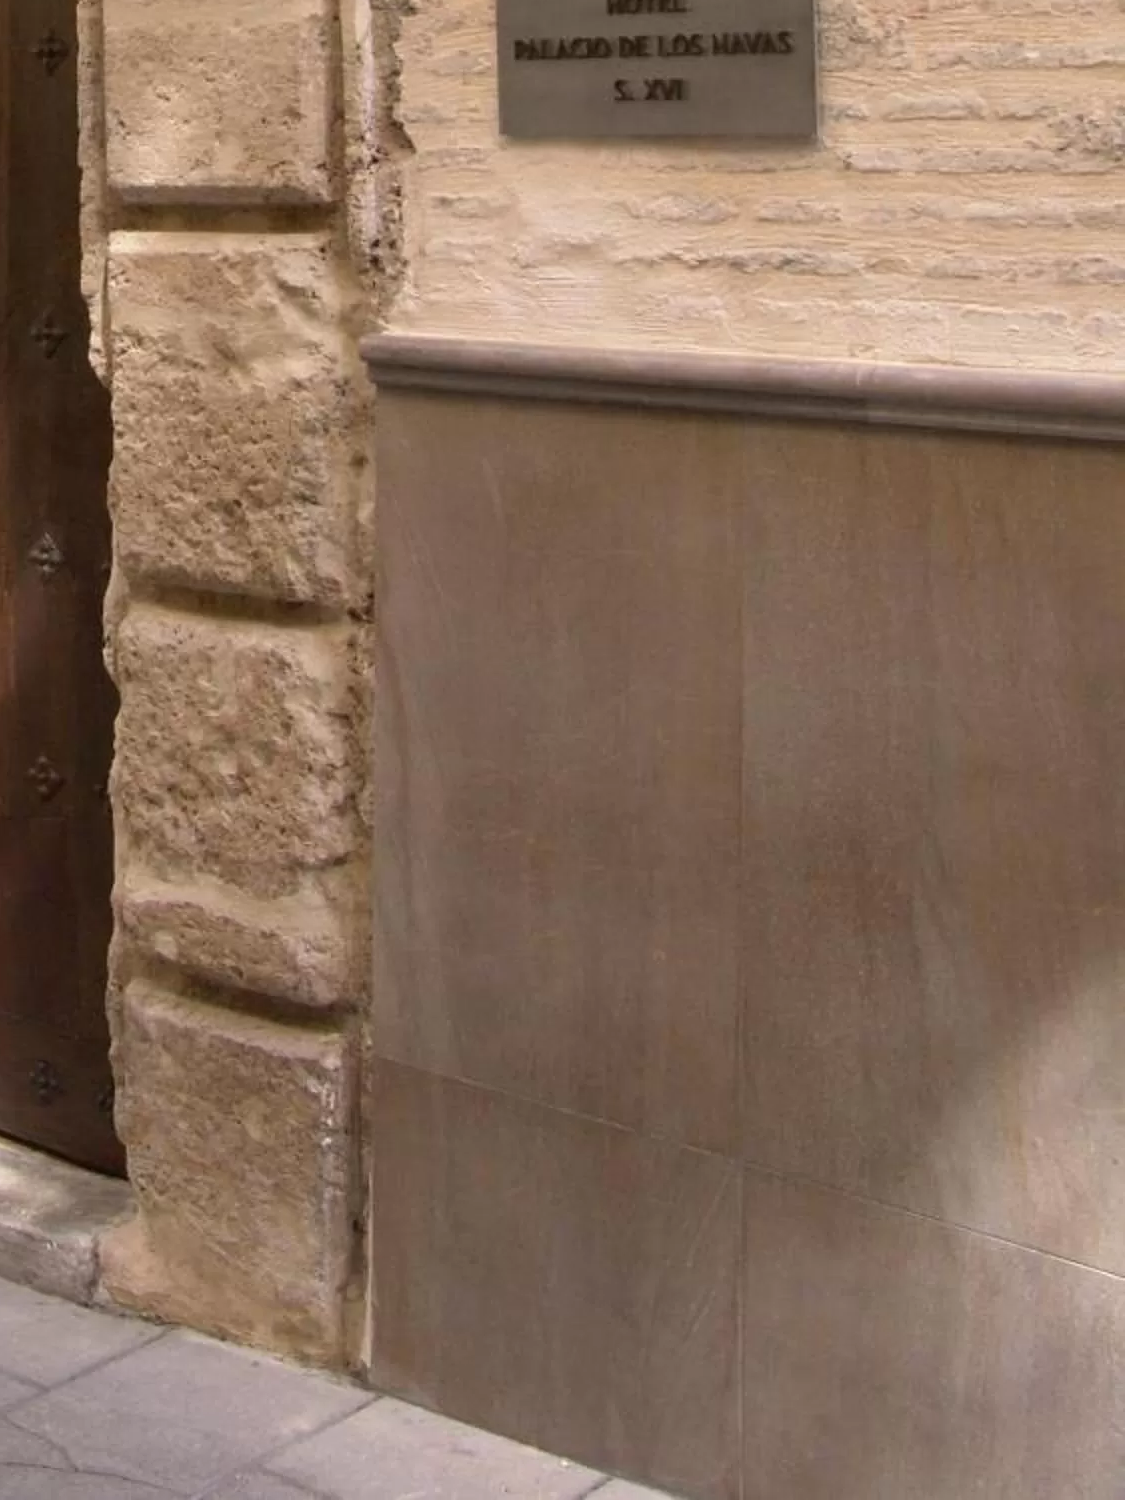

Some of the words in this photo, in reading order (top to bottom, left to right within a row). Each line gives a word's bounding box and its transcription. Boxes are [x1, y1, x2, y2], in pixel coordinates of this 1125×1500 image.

[514, 37, 613, 61] PALACIO
[618, 35, 649, 57] DE
[657, 33, 703, 57] LOS
[711, 31, 794, 55] NAVAS
[644, 78, 686, 101] XVI
